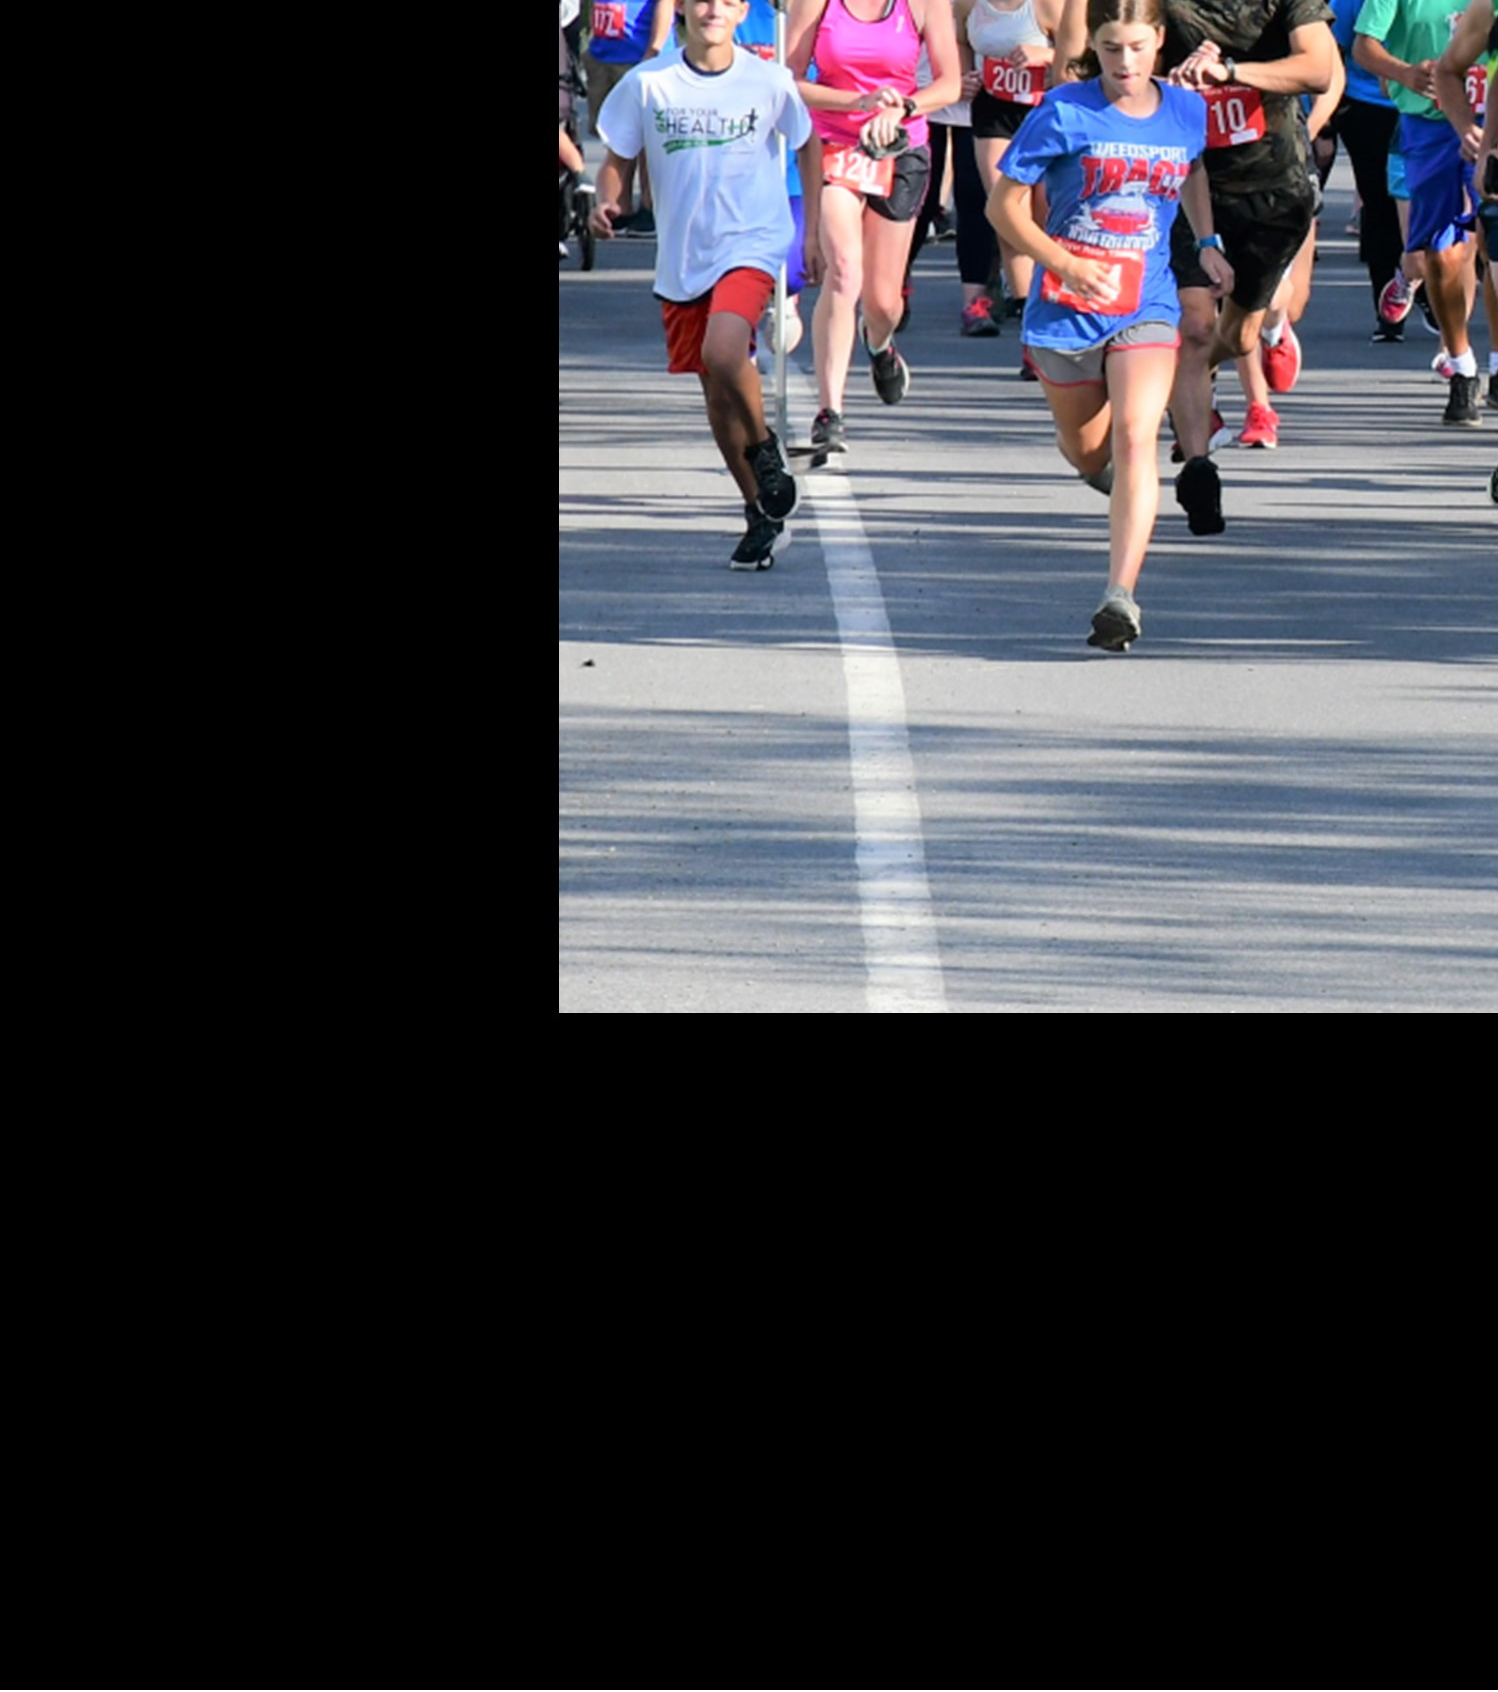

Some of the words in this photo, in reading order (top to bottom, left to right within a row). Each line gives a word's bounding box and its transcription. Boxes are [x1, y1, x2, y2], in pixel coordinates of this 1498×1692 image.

[993, 66, 1032, 94] 200
[1210, 97, 1247, 134] 10
[831, 151, 877, 184] 120
